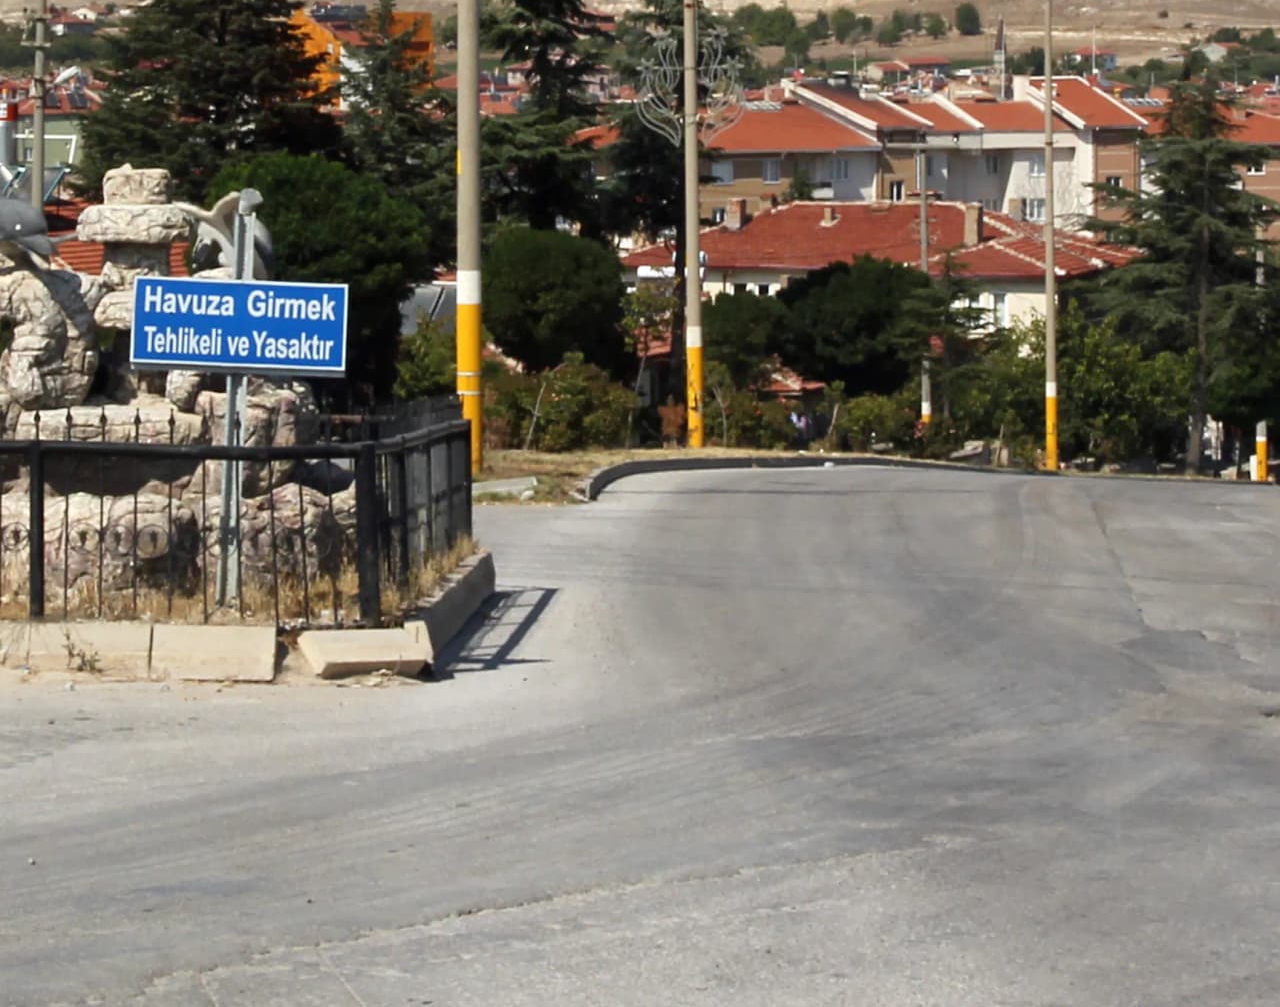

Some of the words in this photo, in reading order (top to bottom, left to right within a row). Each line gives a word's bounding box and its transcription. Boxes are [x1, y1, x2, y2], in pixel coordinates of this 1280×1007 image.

[144, 285, 235, 316] Havuza
[247, 290, 336, 321] Girmek
[144, 326, 222, 356] Tehlikeli
[227, 336, 250, 357] ve
[252, 330, 335, 361] Yasaktır
